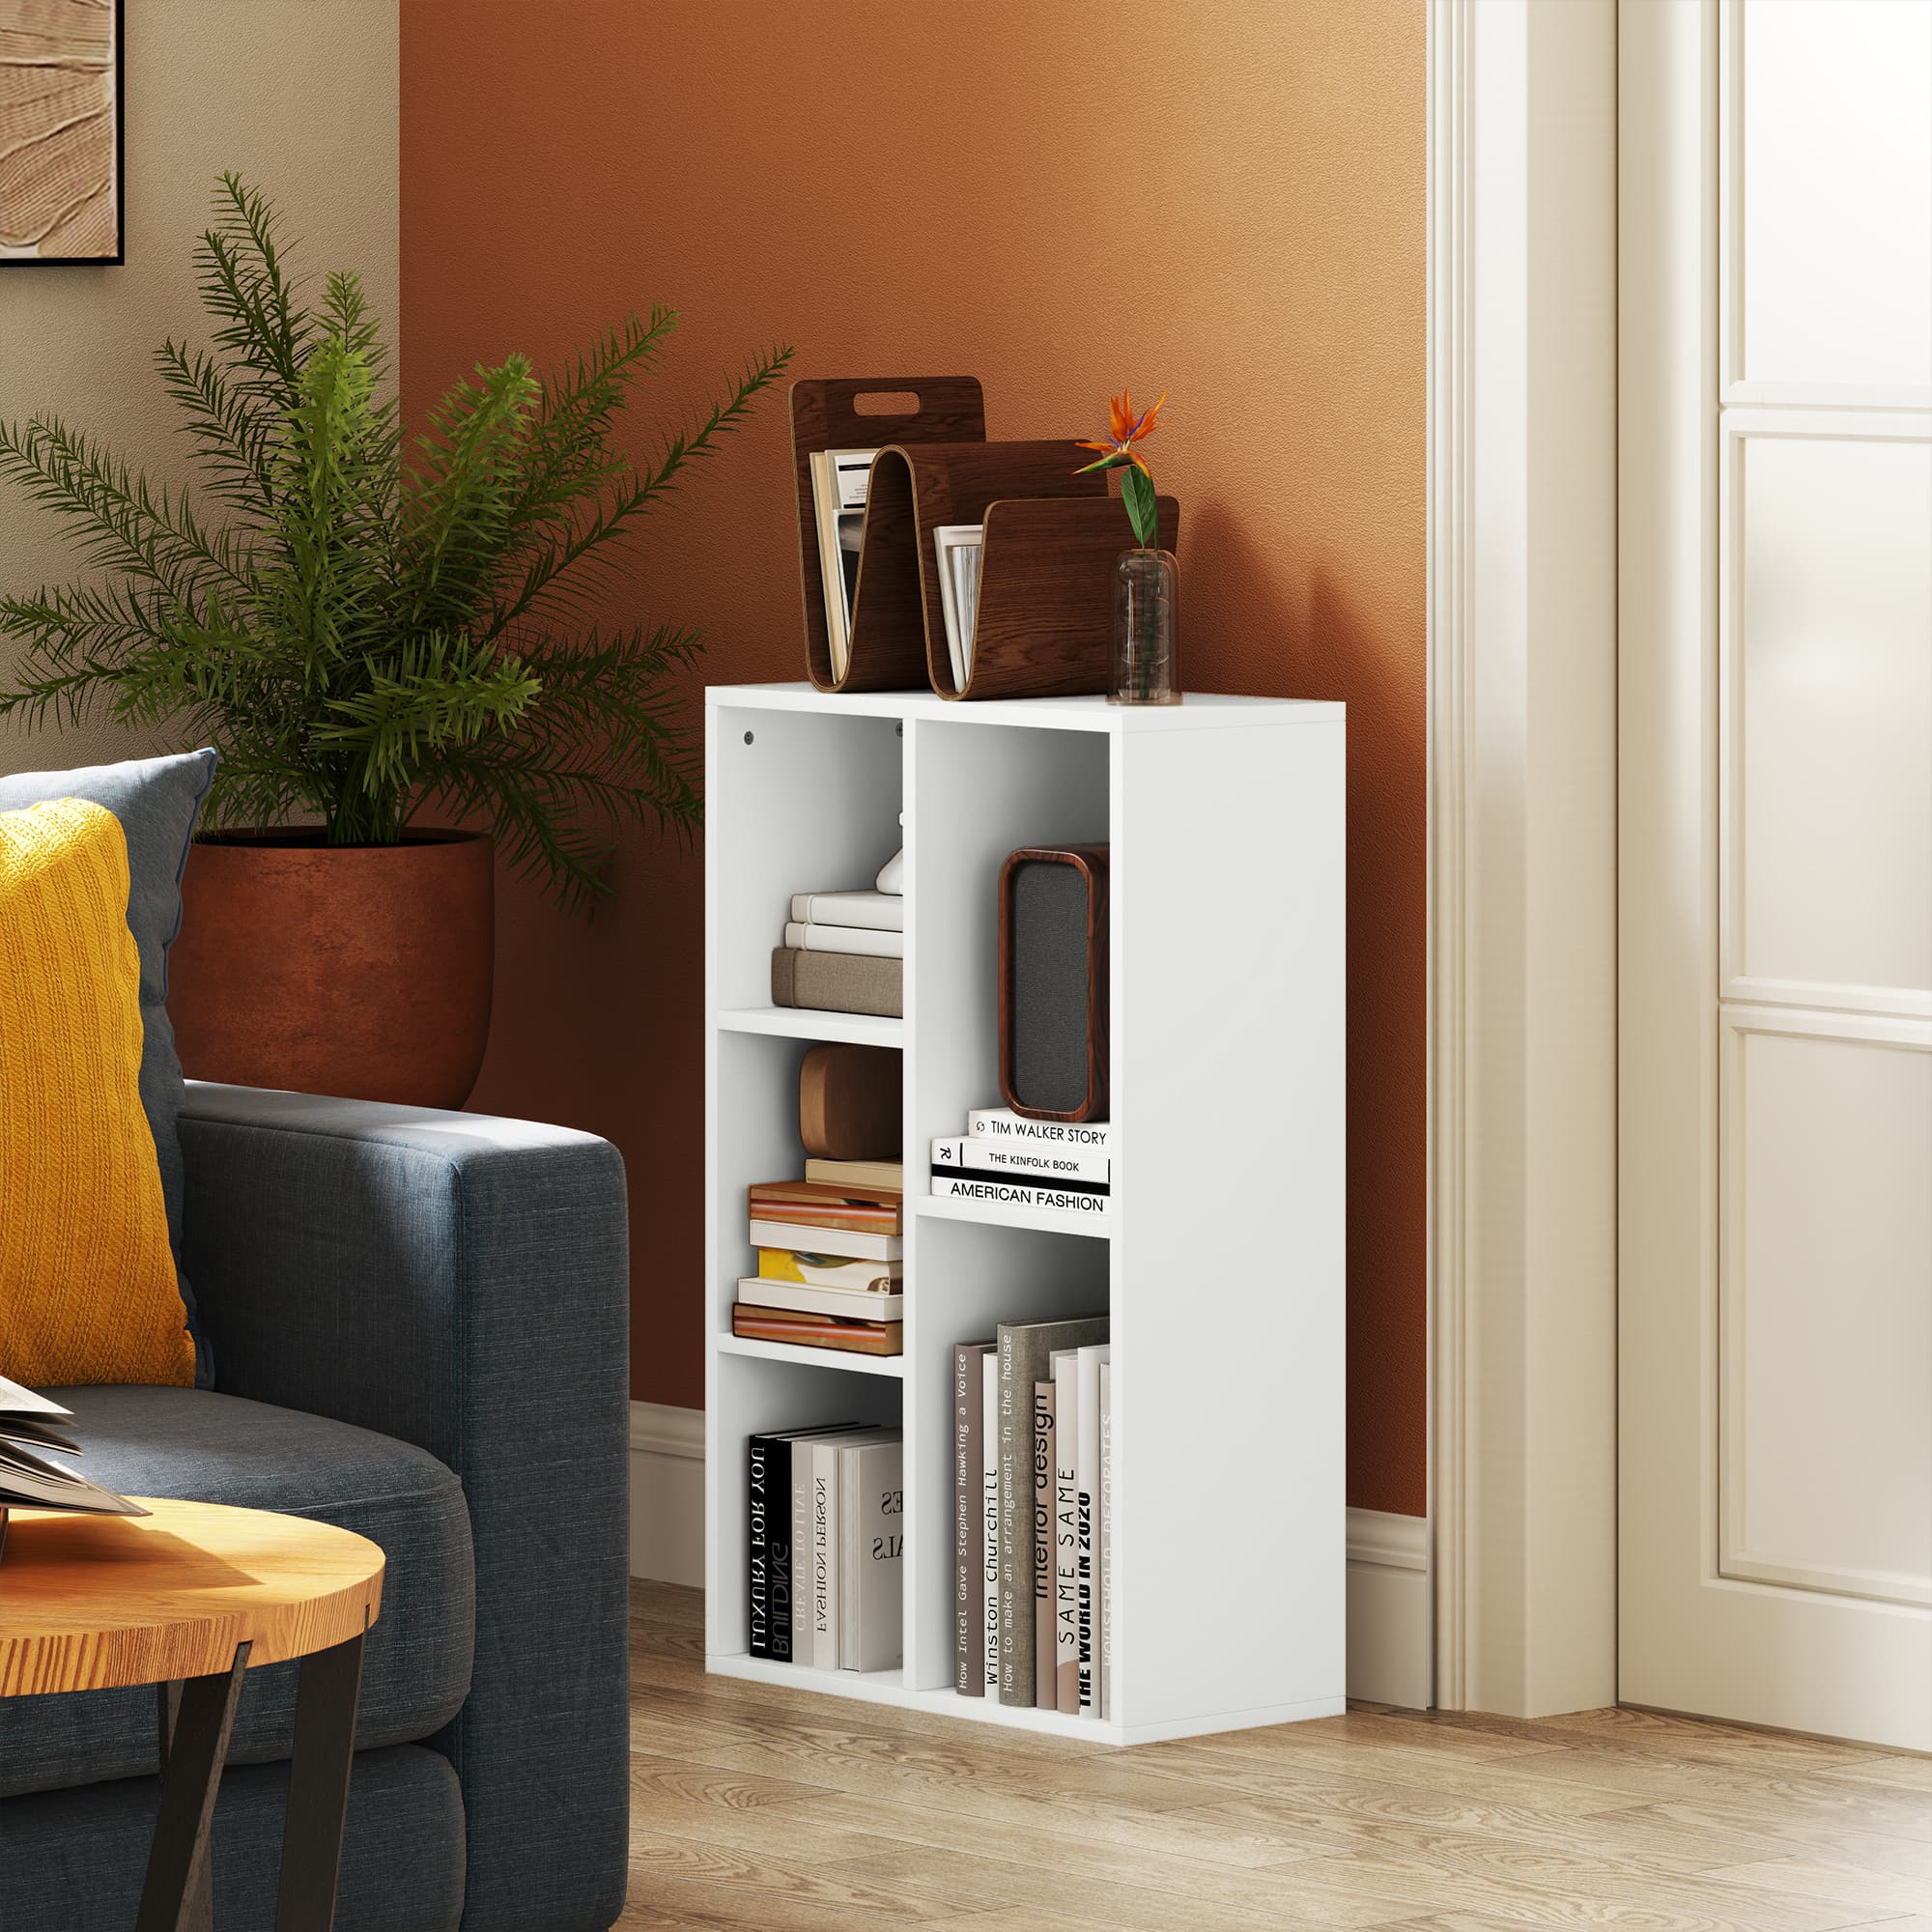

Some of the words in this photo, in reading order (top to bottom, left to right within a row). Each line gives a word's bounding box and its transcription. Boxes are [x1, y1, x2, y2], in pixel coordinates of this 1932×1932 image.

[991, 1121, 1011, 1135] TIM
[1014, 1123, 1065, 1141] WALKER
[1067, 1129, 1107, 1146] STORY
[989, 1152, 1008, 1164] THE
[1010, 1155, 1050, 1169] KINFOLK
[1053, 1160, 1080, 1172] BOOK
[951, 1182, 1031, 1204] AMERICAN
[1037, 1192, 1104, 1212] FASHION
[1002, 1335, 1012, 1380] house
[958, 1406, 966, 1415] a
[1002, 1389, 1012, 1416] the
[1002, 1427, 1012, 1443] in
[1036, 1395, 1053, 1490] design
[958, 1424, 969, 1487] Hawking
[1003, 1454, 1015, 1554] arrangement
[1059, 1468, 1074, 1547] SAME
[1078, 1492, 1091, 1550] 2020
[958, 1494, 969, 1556] Stephen
[985, 1468, 998, 1582] Churchill
[1036, 1503, 1048, 1599] Interior
[1078, 1555, 1091, 1578] IN
[958, 1565, 967, 1601] Gave
[1005, 1563, 1012, 1581] an
[1003, 1591, 1013, 1629] make
[1059, 1565, 1074, 1645] SAME
[1078, 1584, 1092, 1662] WORLD
[958, 1609, 967, 1654] Intel
[985, 1596, 998, 1685] Winston
[1003, 1638, 1013, 1654] to
[958, 1662, 967, 1690] How
[1003, 1663, 1013, 1691] How
[1078, 1669, 1092, 1708] THE
